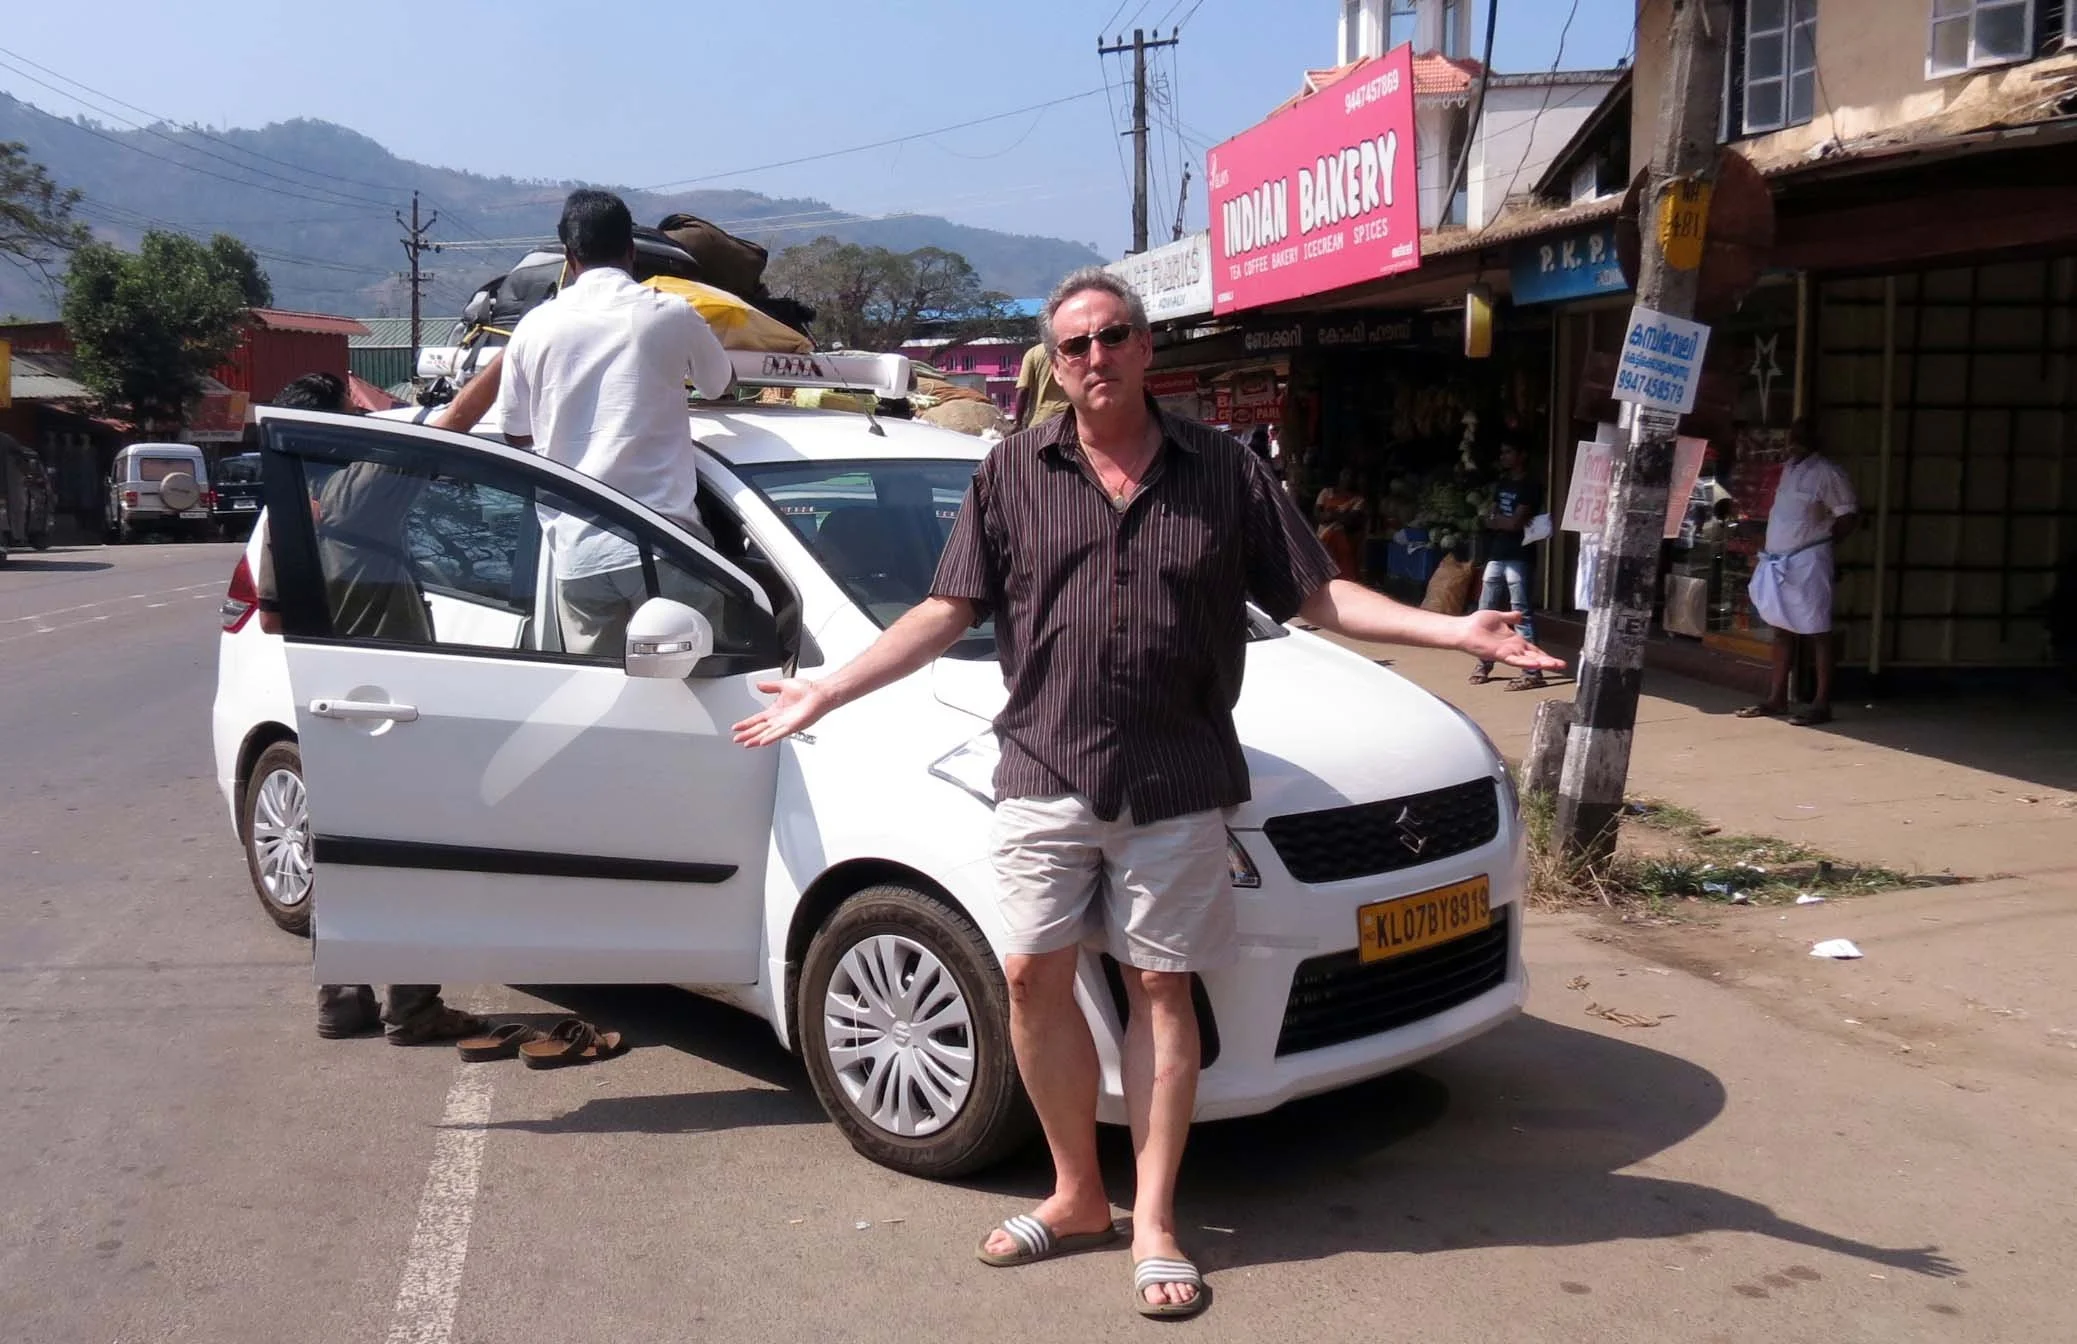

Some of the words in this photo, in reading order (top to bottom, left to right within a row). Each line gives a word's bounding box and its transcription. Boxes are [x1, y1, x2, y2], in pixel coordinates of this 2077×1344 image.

[1223, 176, 1288, 259] INDIAN
[1298, 128, 1398, 235] BAKERY
[1229, 264, 1241, 281] TEA
[1244, 255, 1269, 277] COFFEE
[1272, 246, 1298, 271] BAKERY
[1304, 232, 1344, 261] ICECREAM
[1353, 217, 1389, 246] SPICES
[1377, 885, 1489, 949] KL07BY8919
